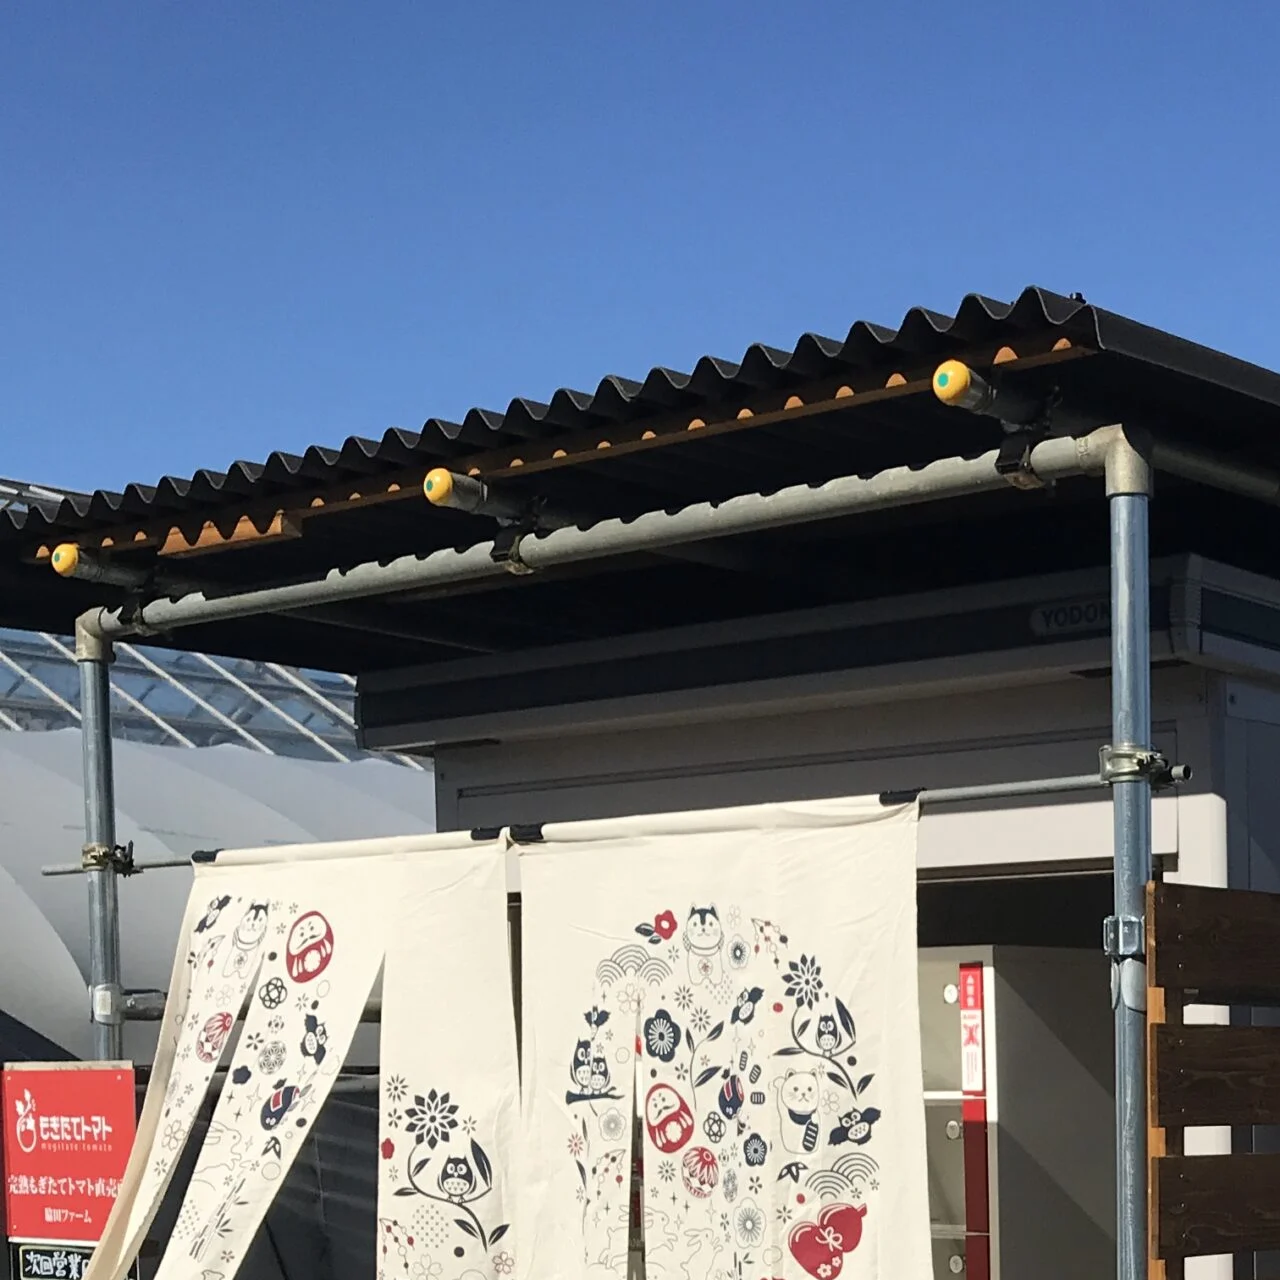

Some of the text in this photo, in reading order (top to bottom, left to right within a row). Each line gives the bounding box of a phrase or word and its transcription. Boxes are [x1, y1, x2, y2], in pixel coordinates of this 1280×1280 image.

[8, 1174, 123, 1199] 完熟もぎたてトマト直売
